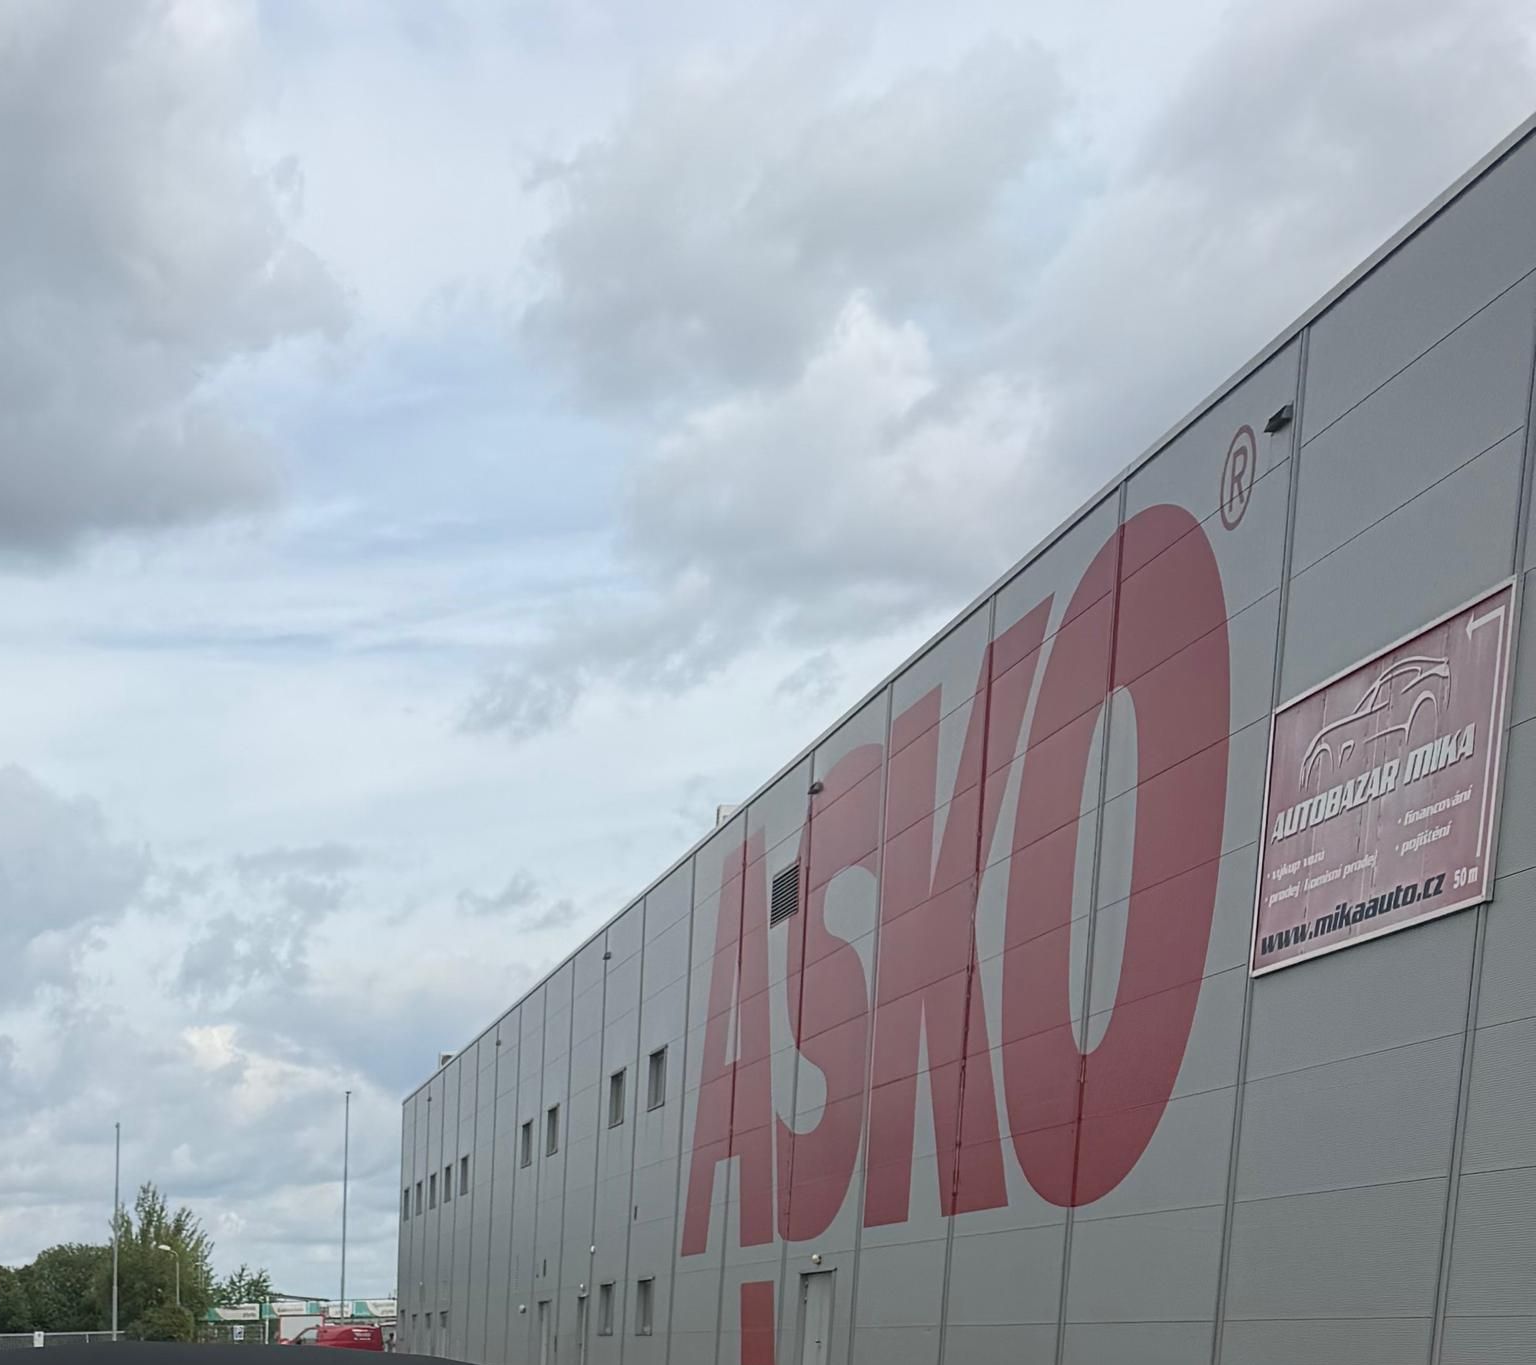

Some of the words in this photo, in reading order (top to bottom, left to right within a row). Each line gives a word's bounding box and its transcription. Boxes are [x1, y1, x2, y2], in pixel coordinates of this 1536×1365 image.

[1270, 757, 1401, 845] AUTOBAZAR
[1403, 721, 1476, 786] MIKA
[1403, 784, 1474, 827] financování
[1400, 820, 1453, 857] pojištění
[680, 503, 1231, 1257] ASKO
[1268, 880, 1301, 909] prodej
[1341, 847, 1378, 880] prodej
[1453, 866, 1467, 890] 50
[1467, 866, 1479, 885] m
[1260, 872, 1446, 956] www.mikaauto.cz
